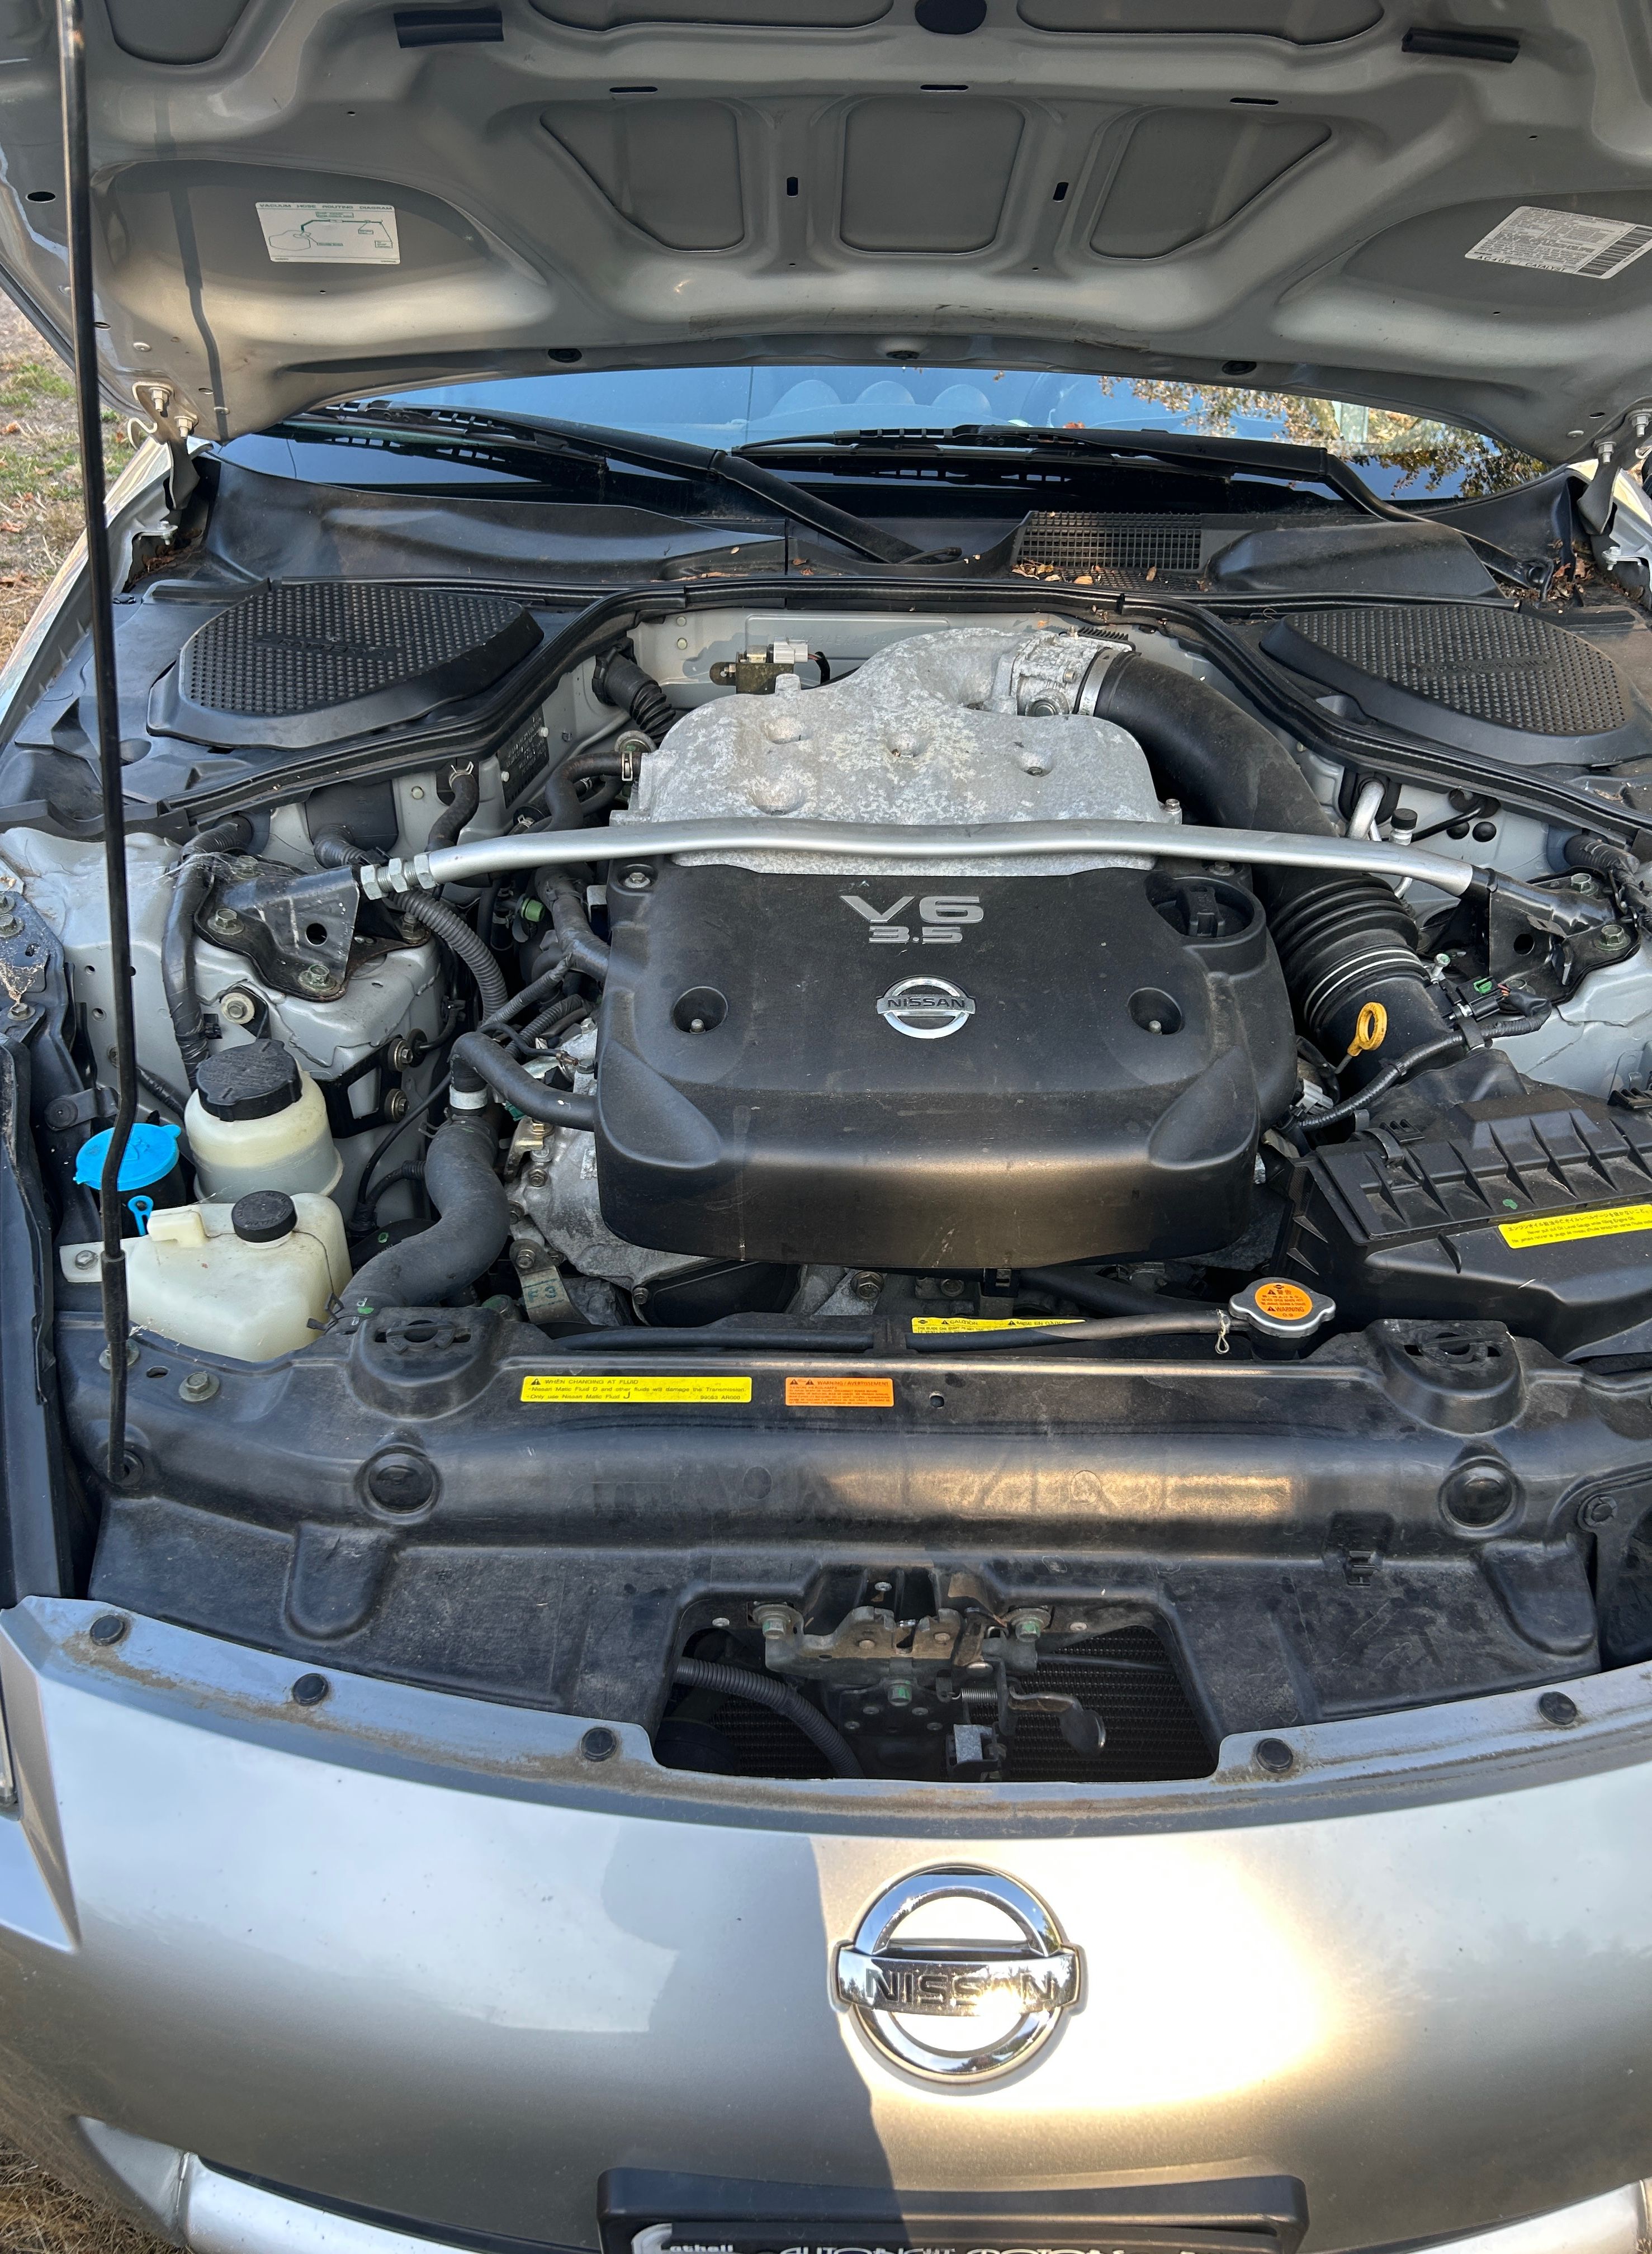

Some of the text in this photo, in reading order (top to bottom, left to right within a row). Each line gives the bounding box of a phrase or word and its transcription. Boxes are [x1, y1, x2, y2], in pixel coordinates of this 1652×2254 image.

[1525, 262, 1565, 272] CATALYST
[840, 896, 984, 924] V6
[869, 926, 963, 944] 3.5
[887, 997, 965, 1007] NISSAN
[865, 1967, 1055, 2004] NISSN
